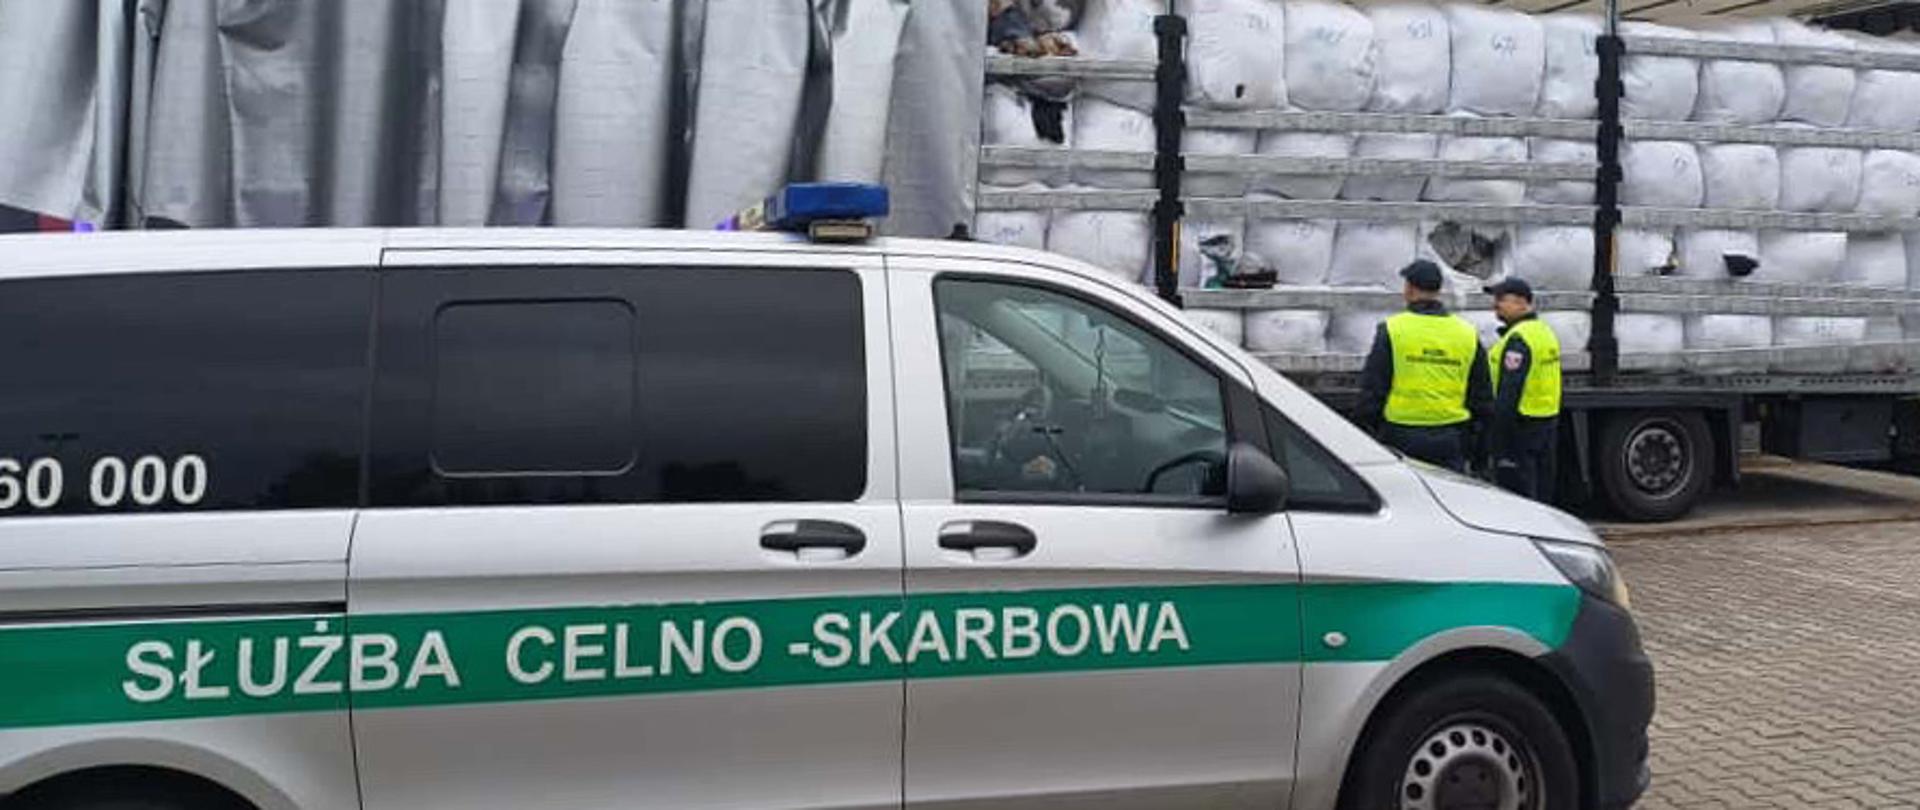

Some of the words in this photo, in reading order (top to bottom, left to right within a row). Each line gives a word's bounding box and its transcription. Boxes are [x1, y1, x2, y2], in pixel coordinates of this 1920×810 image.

[0, 457, 63, 509] 60
[90, 454, 207, 507] 000
[122, 620, 461, 702] SŁUŻBA
[505, 617, 762, 684] CELNO
